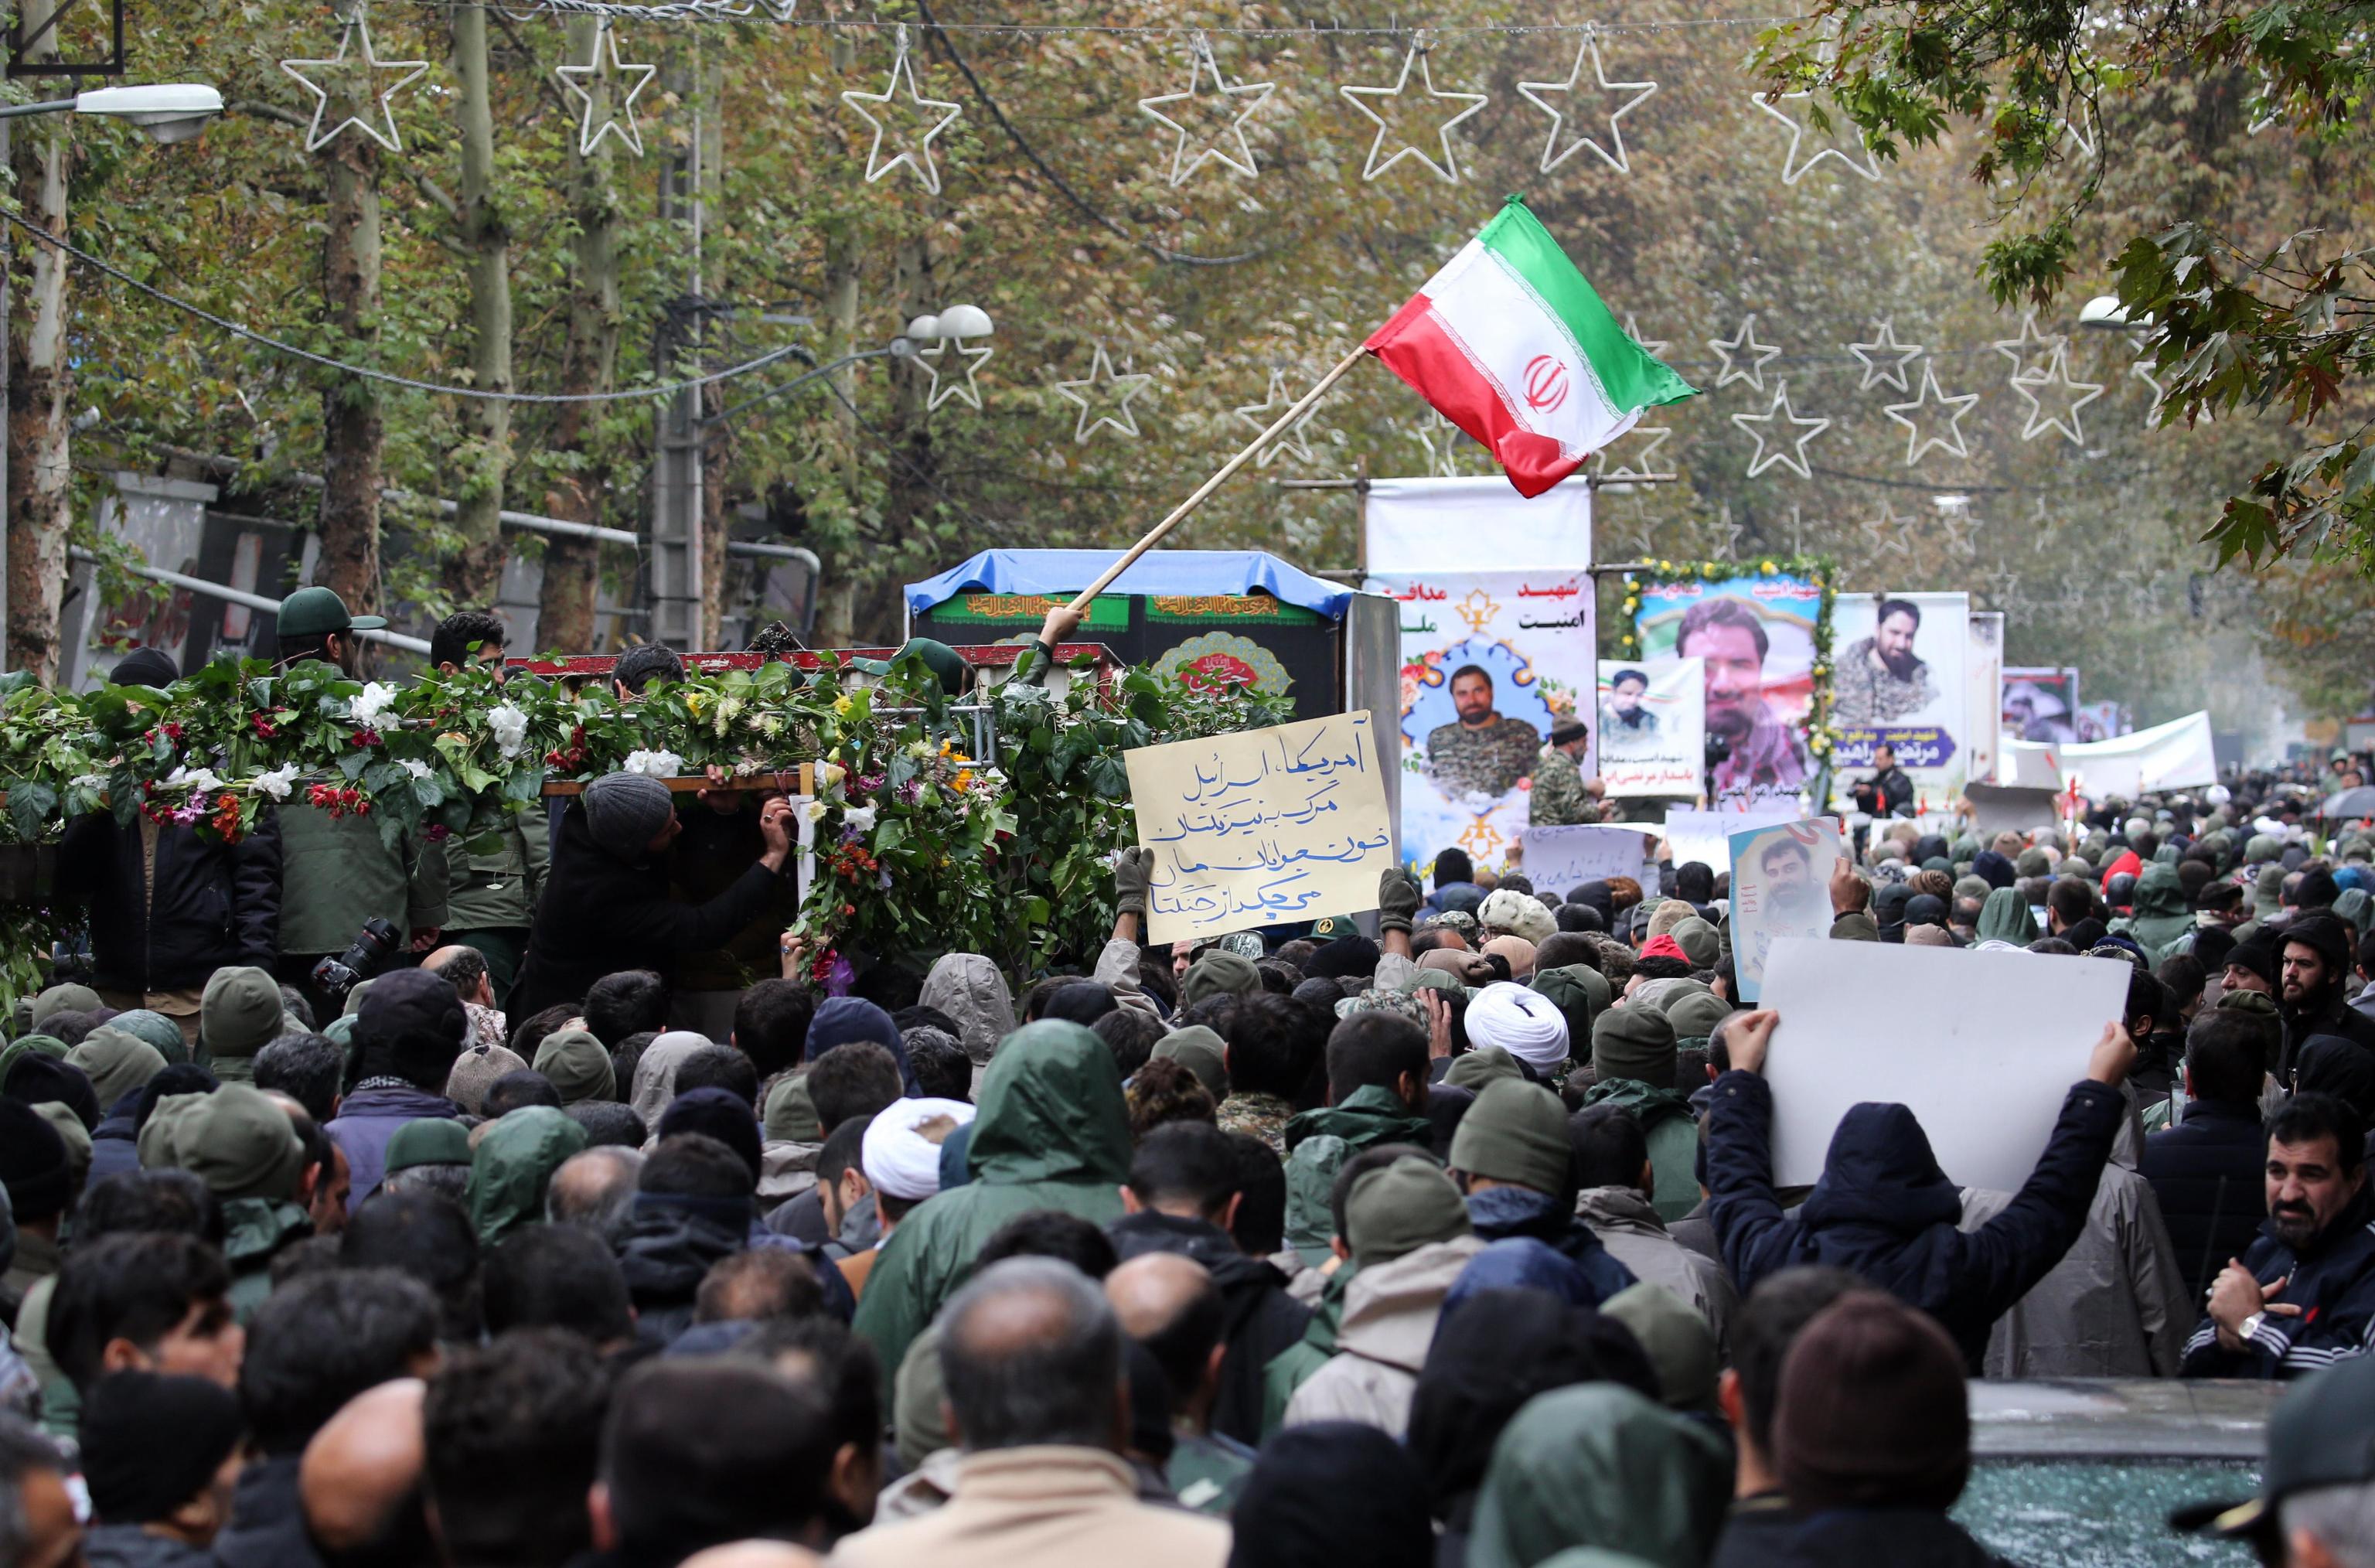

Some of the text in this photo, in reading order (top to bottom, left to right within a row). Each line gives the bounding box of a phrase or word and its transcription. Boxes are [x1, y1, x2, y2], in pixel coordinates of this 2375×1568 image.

[1518, 578, 1579, 602] شهید
[1400, 609, 1585, 634] امنیت مل
[1281, 779, 1341, 825] مرگ
[1305, 827, 1390, 863] خون
